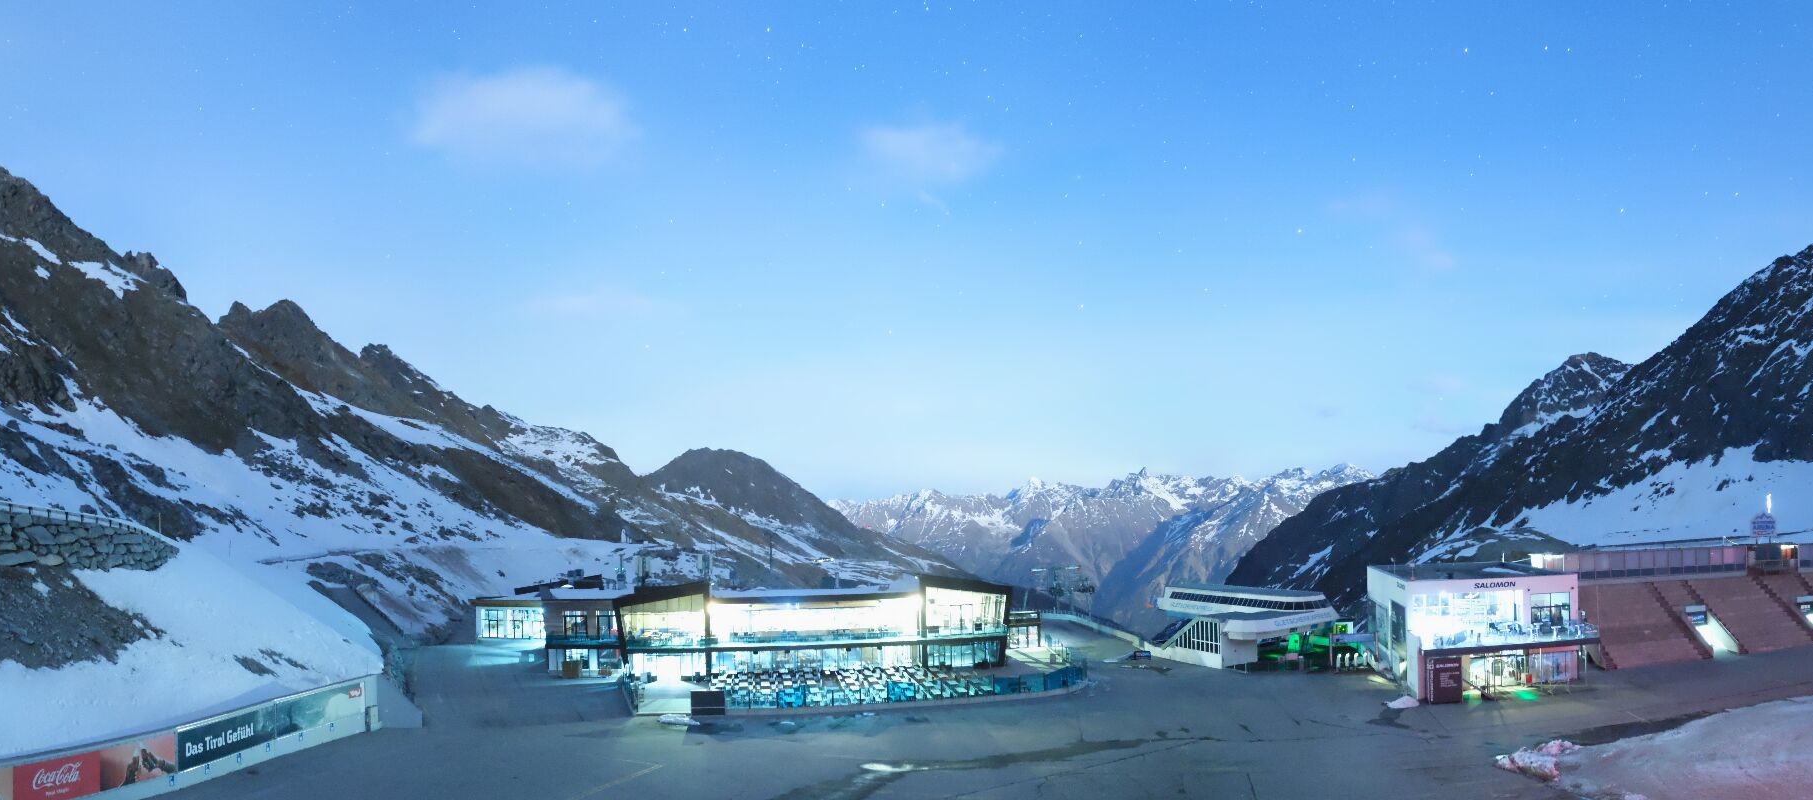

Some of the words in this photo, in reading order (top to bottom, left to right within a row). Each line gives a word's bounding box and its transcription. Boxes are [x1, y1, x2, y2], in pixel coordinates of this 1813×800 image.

[1474, 581, 1516, 589] SALOMON
[185, 742, 203, 757] Das
[205, 732, 225, 750] Tirol
[227, 723, 254, 743] Gefühl
